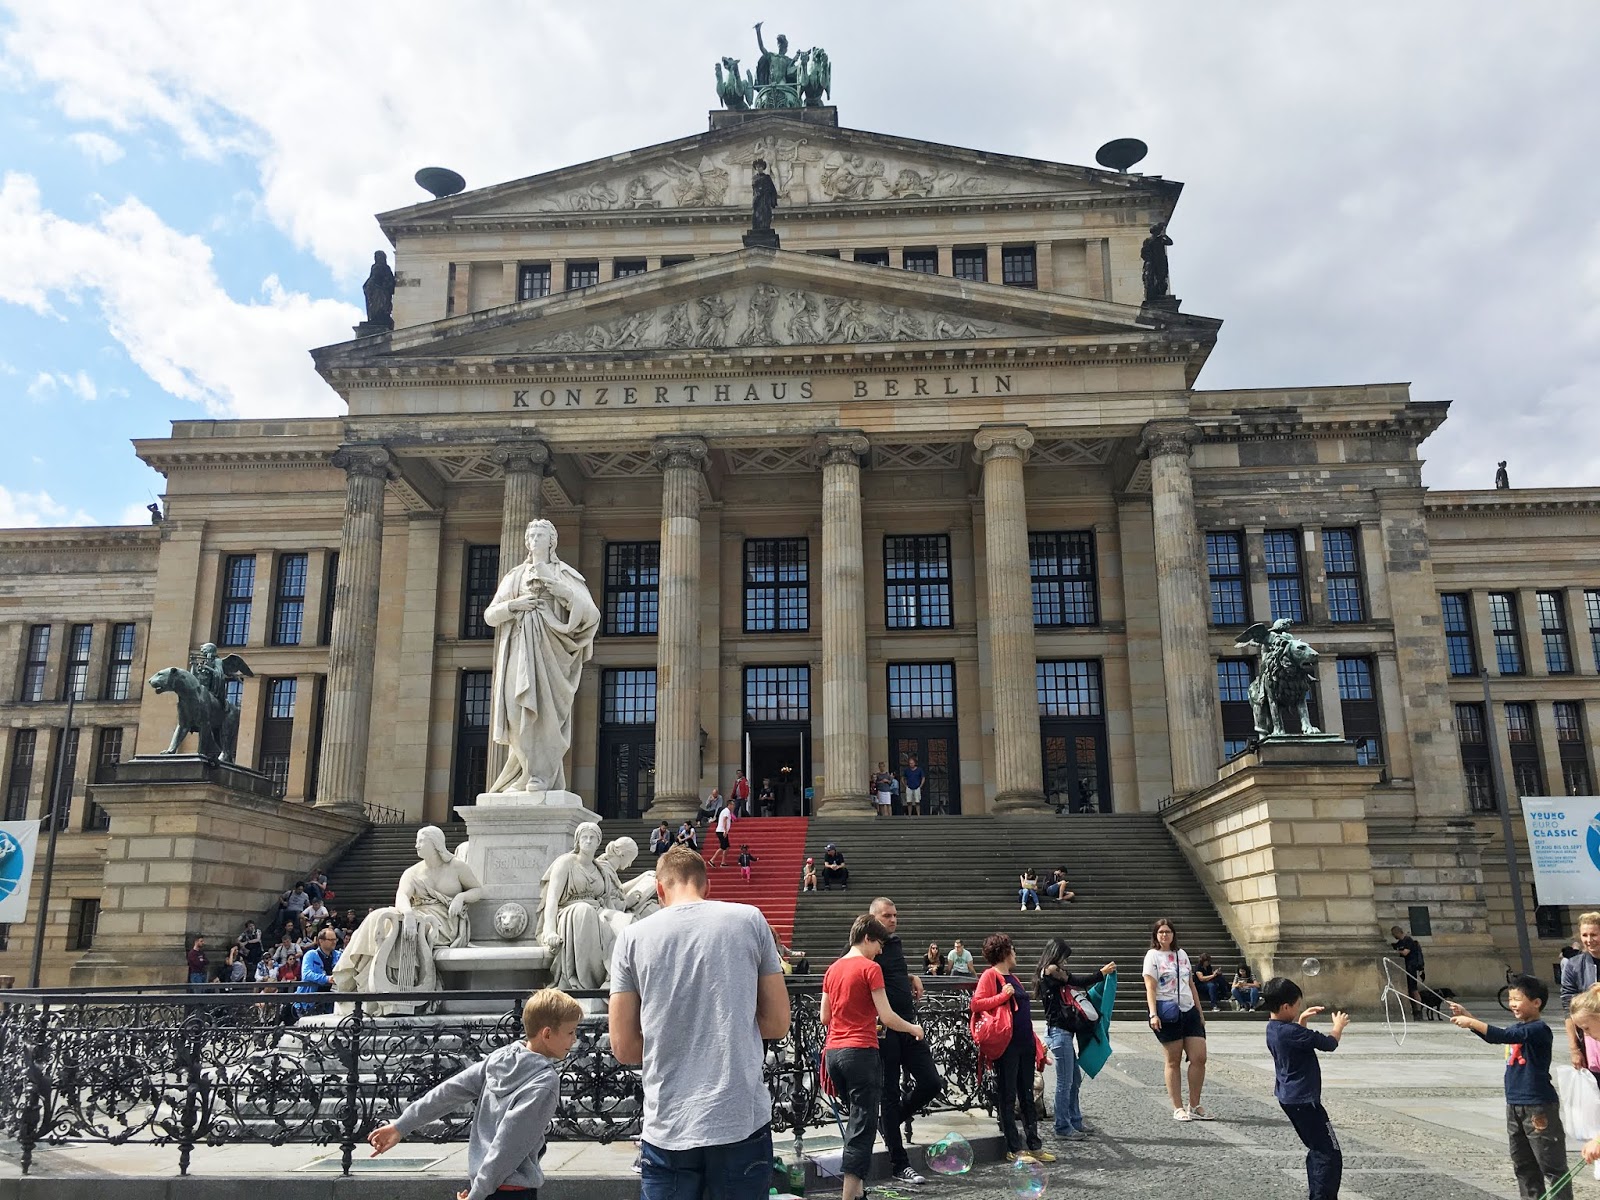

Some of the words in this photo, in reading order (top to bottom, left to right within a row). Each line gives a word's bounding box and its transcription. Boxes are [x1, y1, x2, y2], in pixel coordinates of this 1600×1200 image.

[513, 382, 813, 407] KONZERTHAUS
[854, 375, 1011, 397] BERLIN
[1530, 812, 1565, 820] YOUNG
[1533, 829, 1578, 837] CLASSIC
